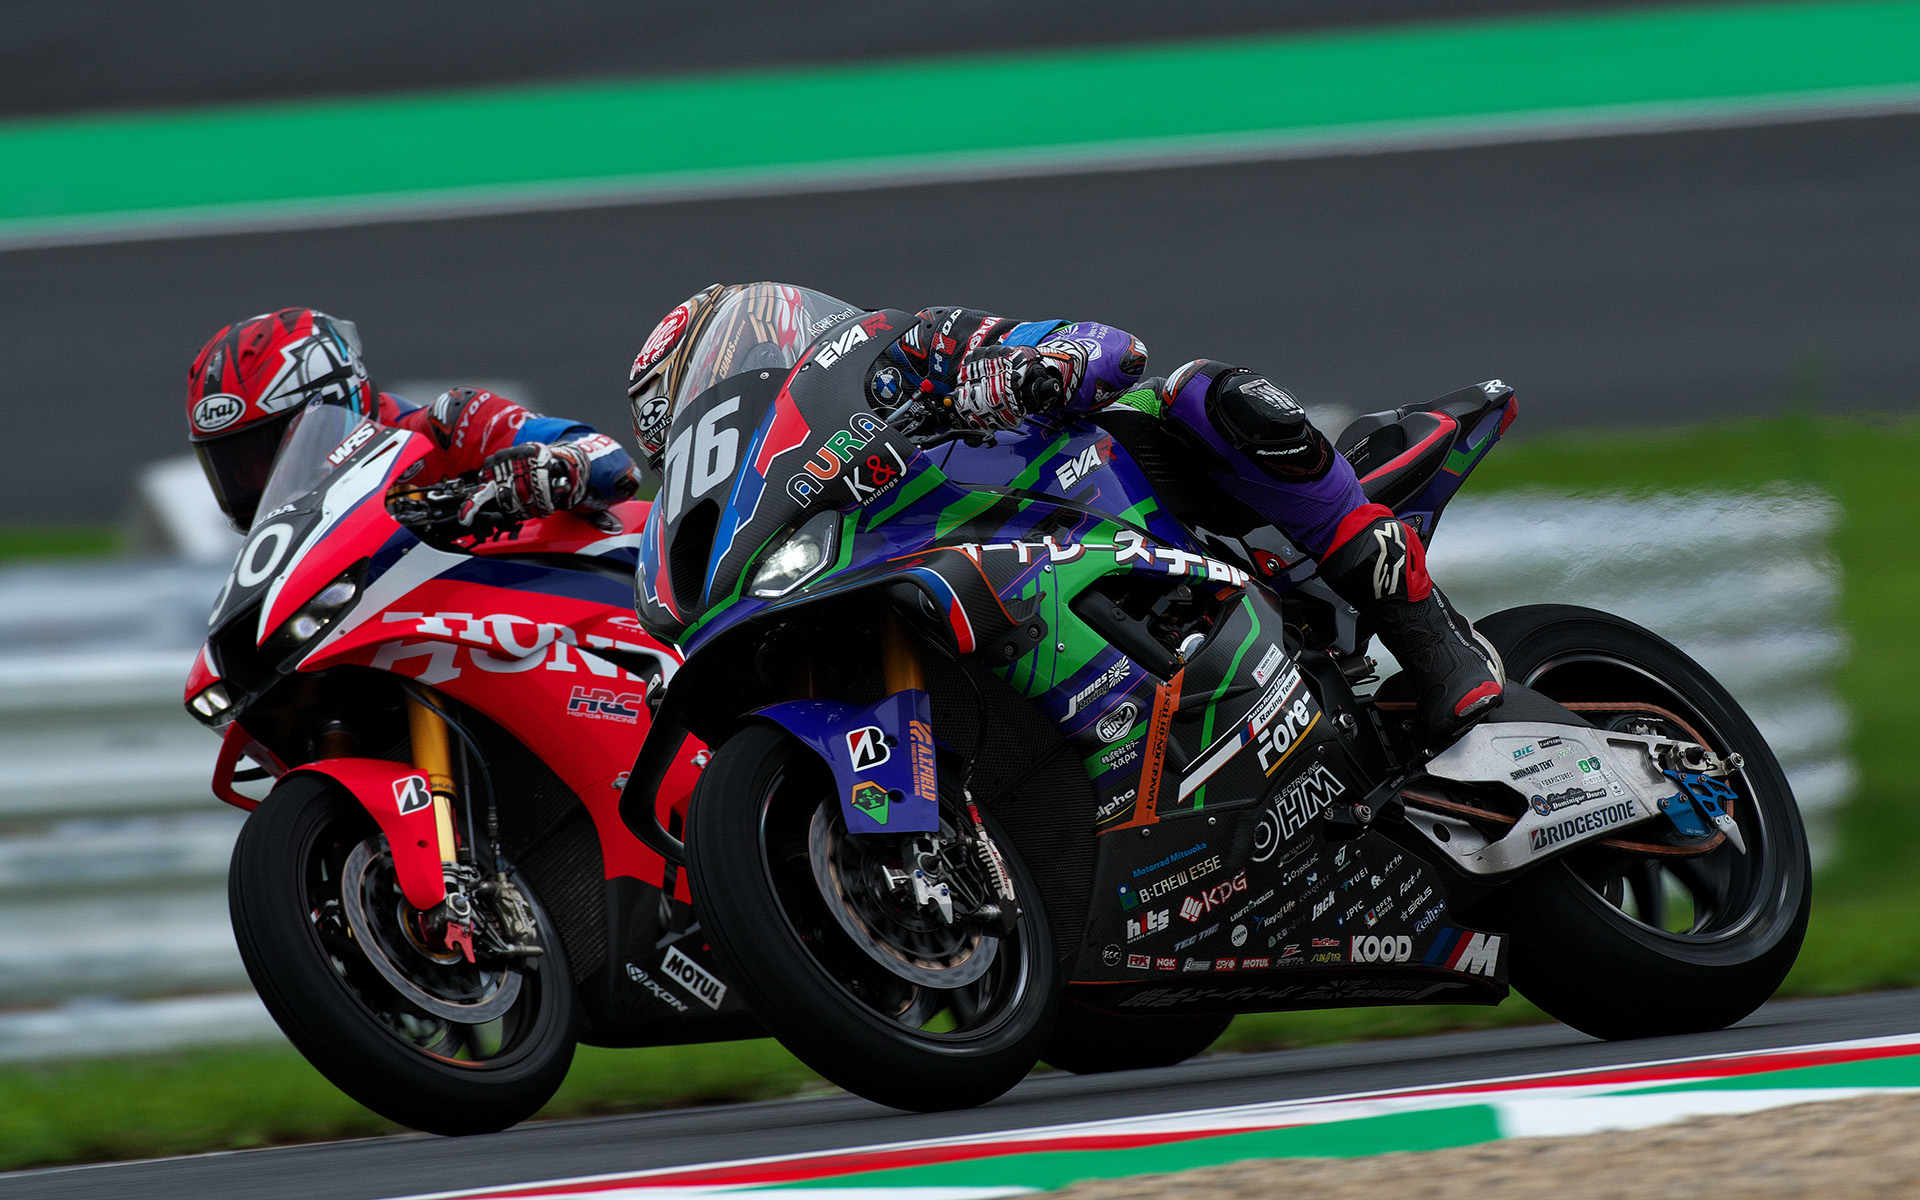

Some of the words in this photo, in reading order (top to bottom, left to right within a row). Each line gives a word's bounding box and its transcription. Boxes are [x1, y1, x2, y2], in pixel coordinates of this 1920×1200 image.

[806, 308, 856, 338] ACRY-Point
[719, 340, 736, 380] CHAOS
[200, 401, 236, 421] Arai
[329, 422, 375, 465] WRS
[643, 414, 675, 444] Kabuto
[786, 412, 888, 508] AURA
[843, 442, 908, 502] K&J
[862, 477, 899, 507] Holdings
[567, 685, 642, 719] HRC
[1059, 671, 1109, 724] James
[1259, 696, 1284, 725] Racing
[1281, 675, 1297, 699] Team
[1102, 714, 1120, 728] TEAM
[1274, 775, 1308, 804] ELECTRIC
[1307, 760, 1322, 777] INC.
[1511, 763, 1540, 781] SHINANO
[1540, 759, 1555, 771] TENT
[1541, 771, 1574, 787] FOXPICTURES
[1552, 795, 1586, 811] Dominique
[1533, 800, 1636, 851] BRIDGESTONE
[992, 851, 1010, 889] brembo
[1132, 857, 1169, 878] Motorrad
[1170, 842, 1207, 863] Mitsuoka
[1189, 854, 1222, 881] ESSE
[1299, 874, 1331, 903] CONQUEST
[1350, 866, 1368, 887] YUEI
[1202, 871, 1247, 913] KDG
[1312, 890, 1336, 922] Jack
[1375, 895, 1392, 912] OPEN
[1127, 908, 1170, 940] hits
[1263, 913, 1277, 928] Key
[1283, 900, 1296, 914] Life
[1345, 901, 1364, 920] JPYC
[1378, 903, 1394, 918] HOUSE
[1129, 955, 1149, 966] RK
[1156, 958, 1175, 967] NGK
[1243, 958, 1269, 968] MOTUL
[1351, 935, 1413, 963] KOOD
[665, 954, 720, 1004] MOTUL
